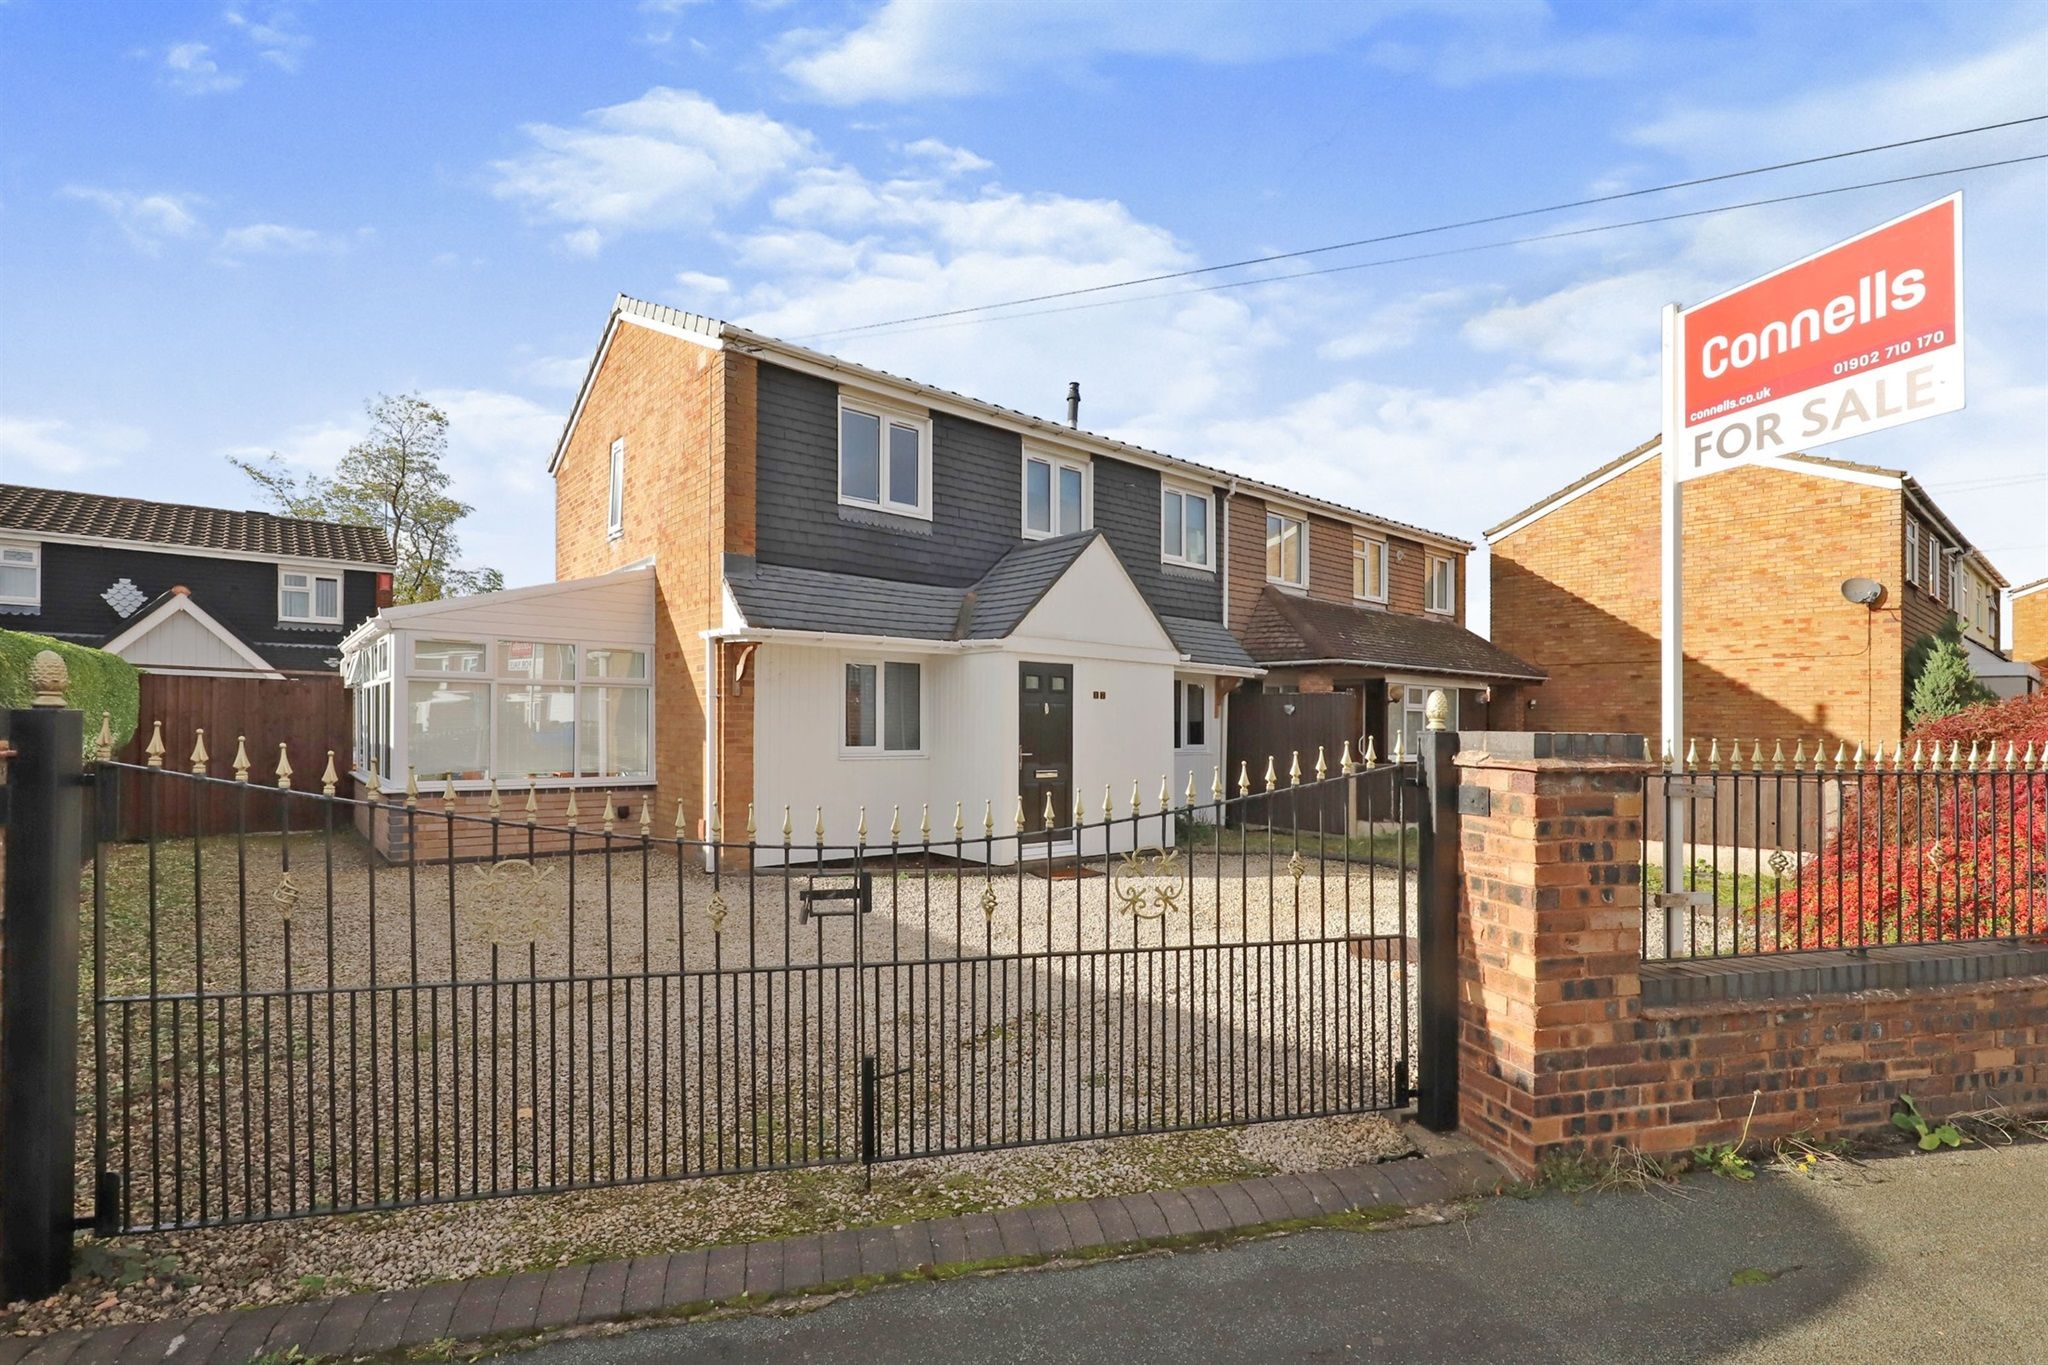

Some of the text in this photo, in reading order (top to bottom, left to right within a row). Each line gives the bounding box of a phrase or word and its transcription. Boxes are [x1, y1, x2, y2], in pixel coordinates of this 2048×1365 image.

[1702, 268, 1926, 379] Connells
[1833, 330, 1944, 375] 01902 710 170
[1690, 386, 1771, 421] connells.co.uk
[1694, 363, 1935, 467] FOR SALE
